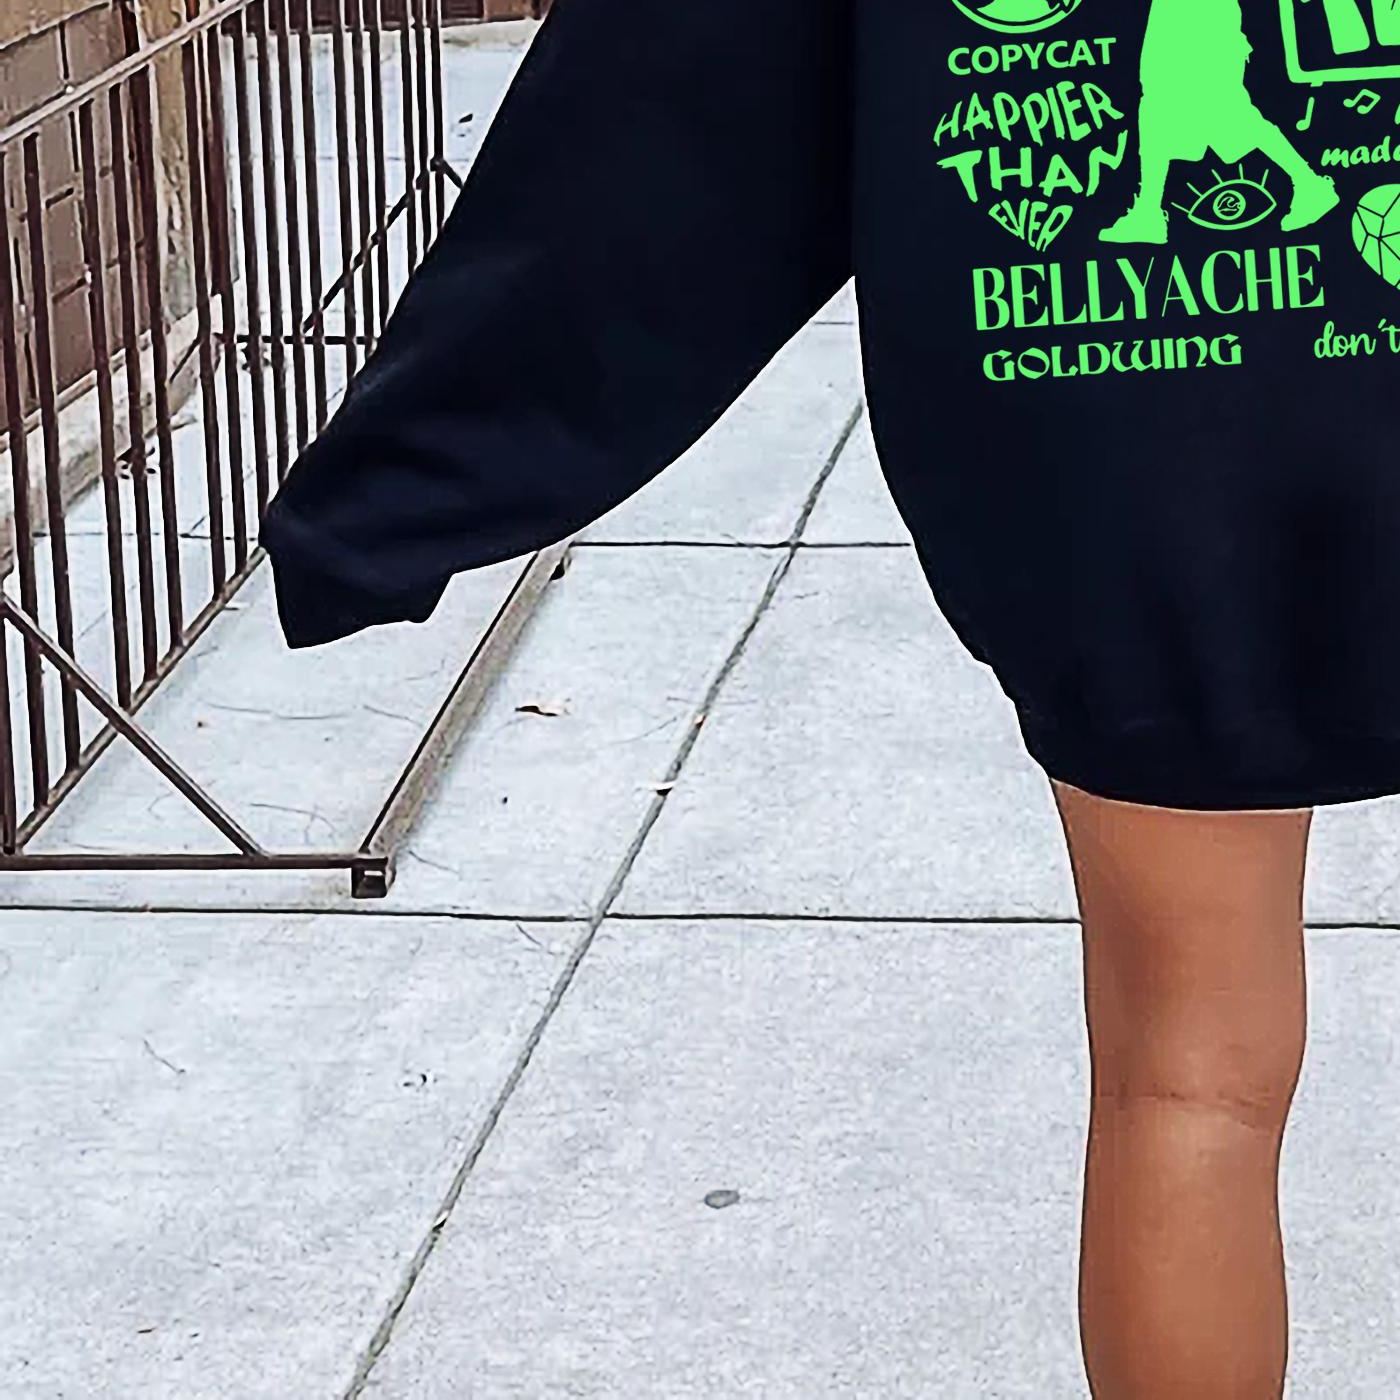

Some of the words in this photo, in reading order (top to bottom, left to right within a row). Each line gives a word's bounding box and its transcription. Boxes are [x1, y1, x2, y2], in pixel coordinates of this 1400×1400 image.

[946, 37, 1117, 76] COPYCAT
[933, 80, 1125, 147] HAPPIER
[936, 129, 1129, 203] THAN
[987, 197, 1074, 253] EVER
[971, 244, 1326, 332] BELLYACHE
[981, 332, 1242, 383] GOLDWING
